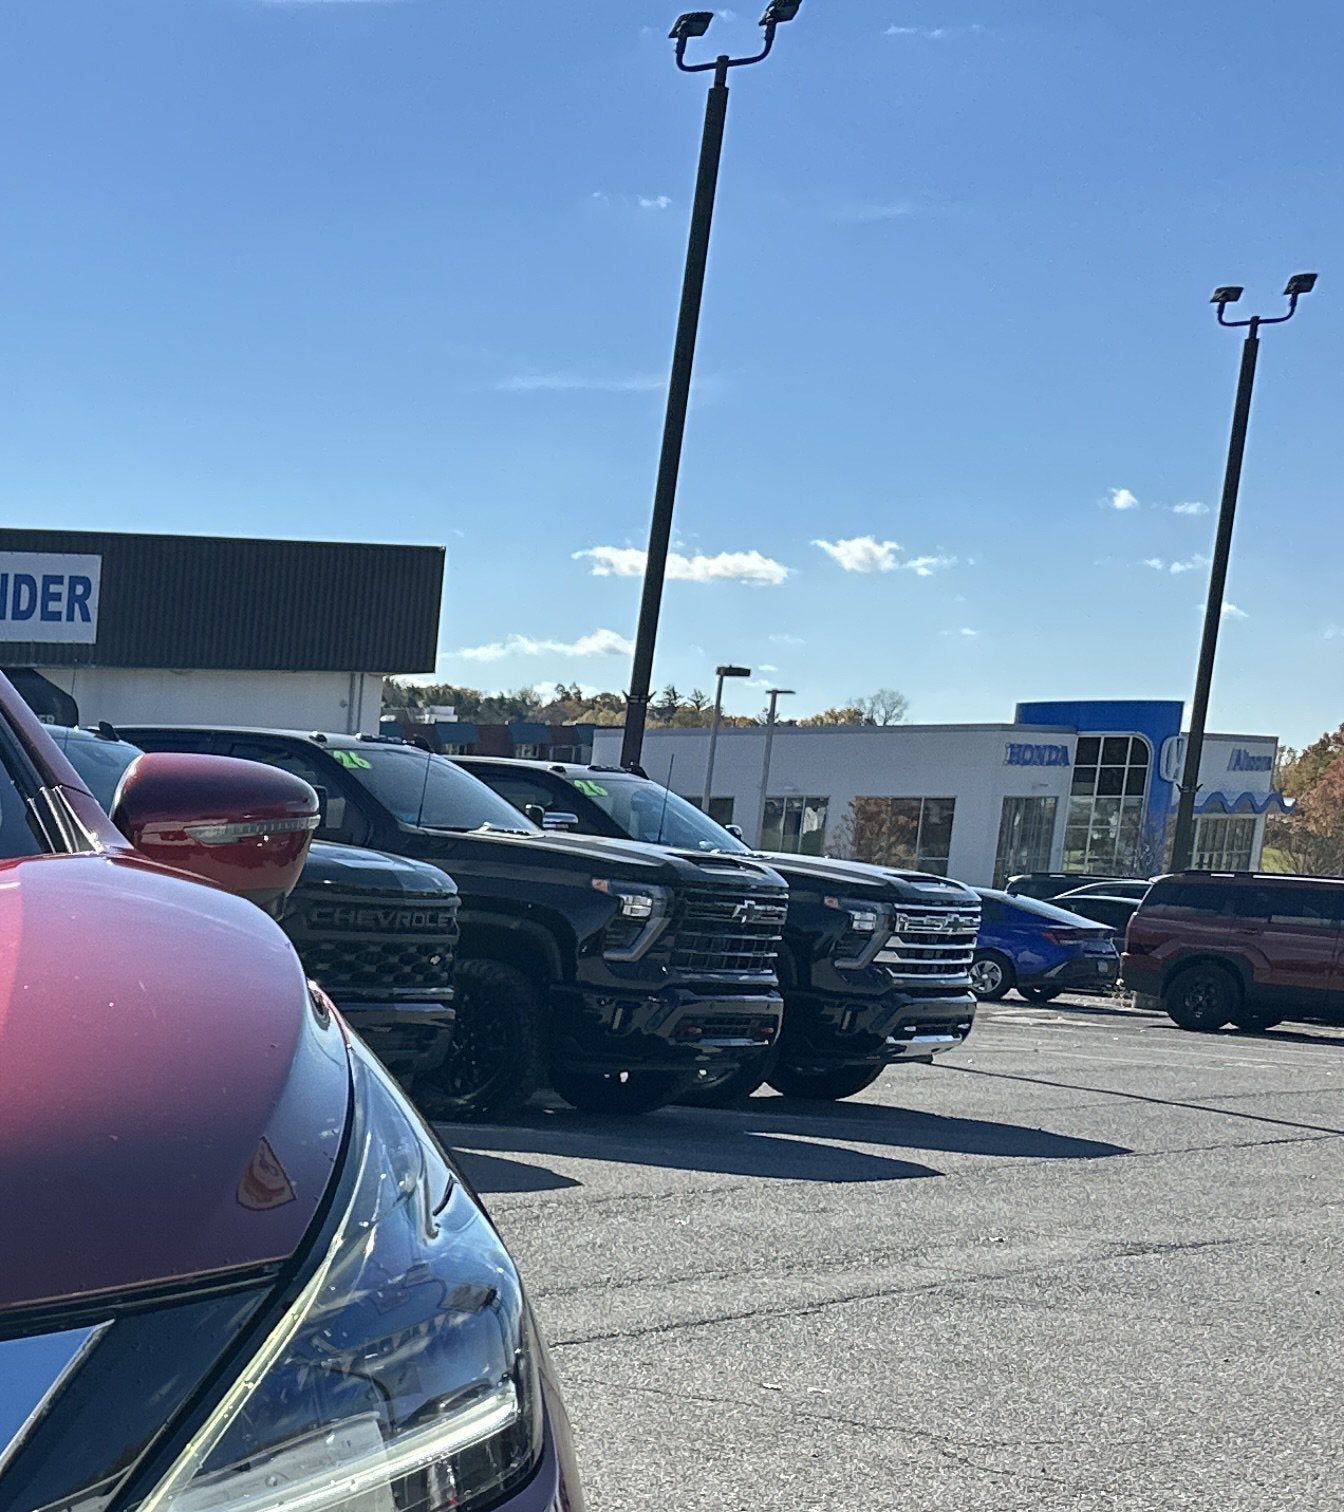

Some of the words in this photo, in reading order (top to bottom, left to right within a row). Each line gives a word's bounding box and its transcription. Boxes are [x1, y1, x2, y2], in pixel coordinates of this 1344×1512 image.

[333, 750, 373, 769] 26
[1007, 744, 1070, 766] HONDA
[574, 779, 609, 797] 26
